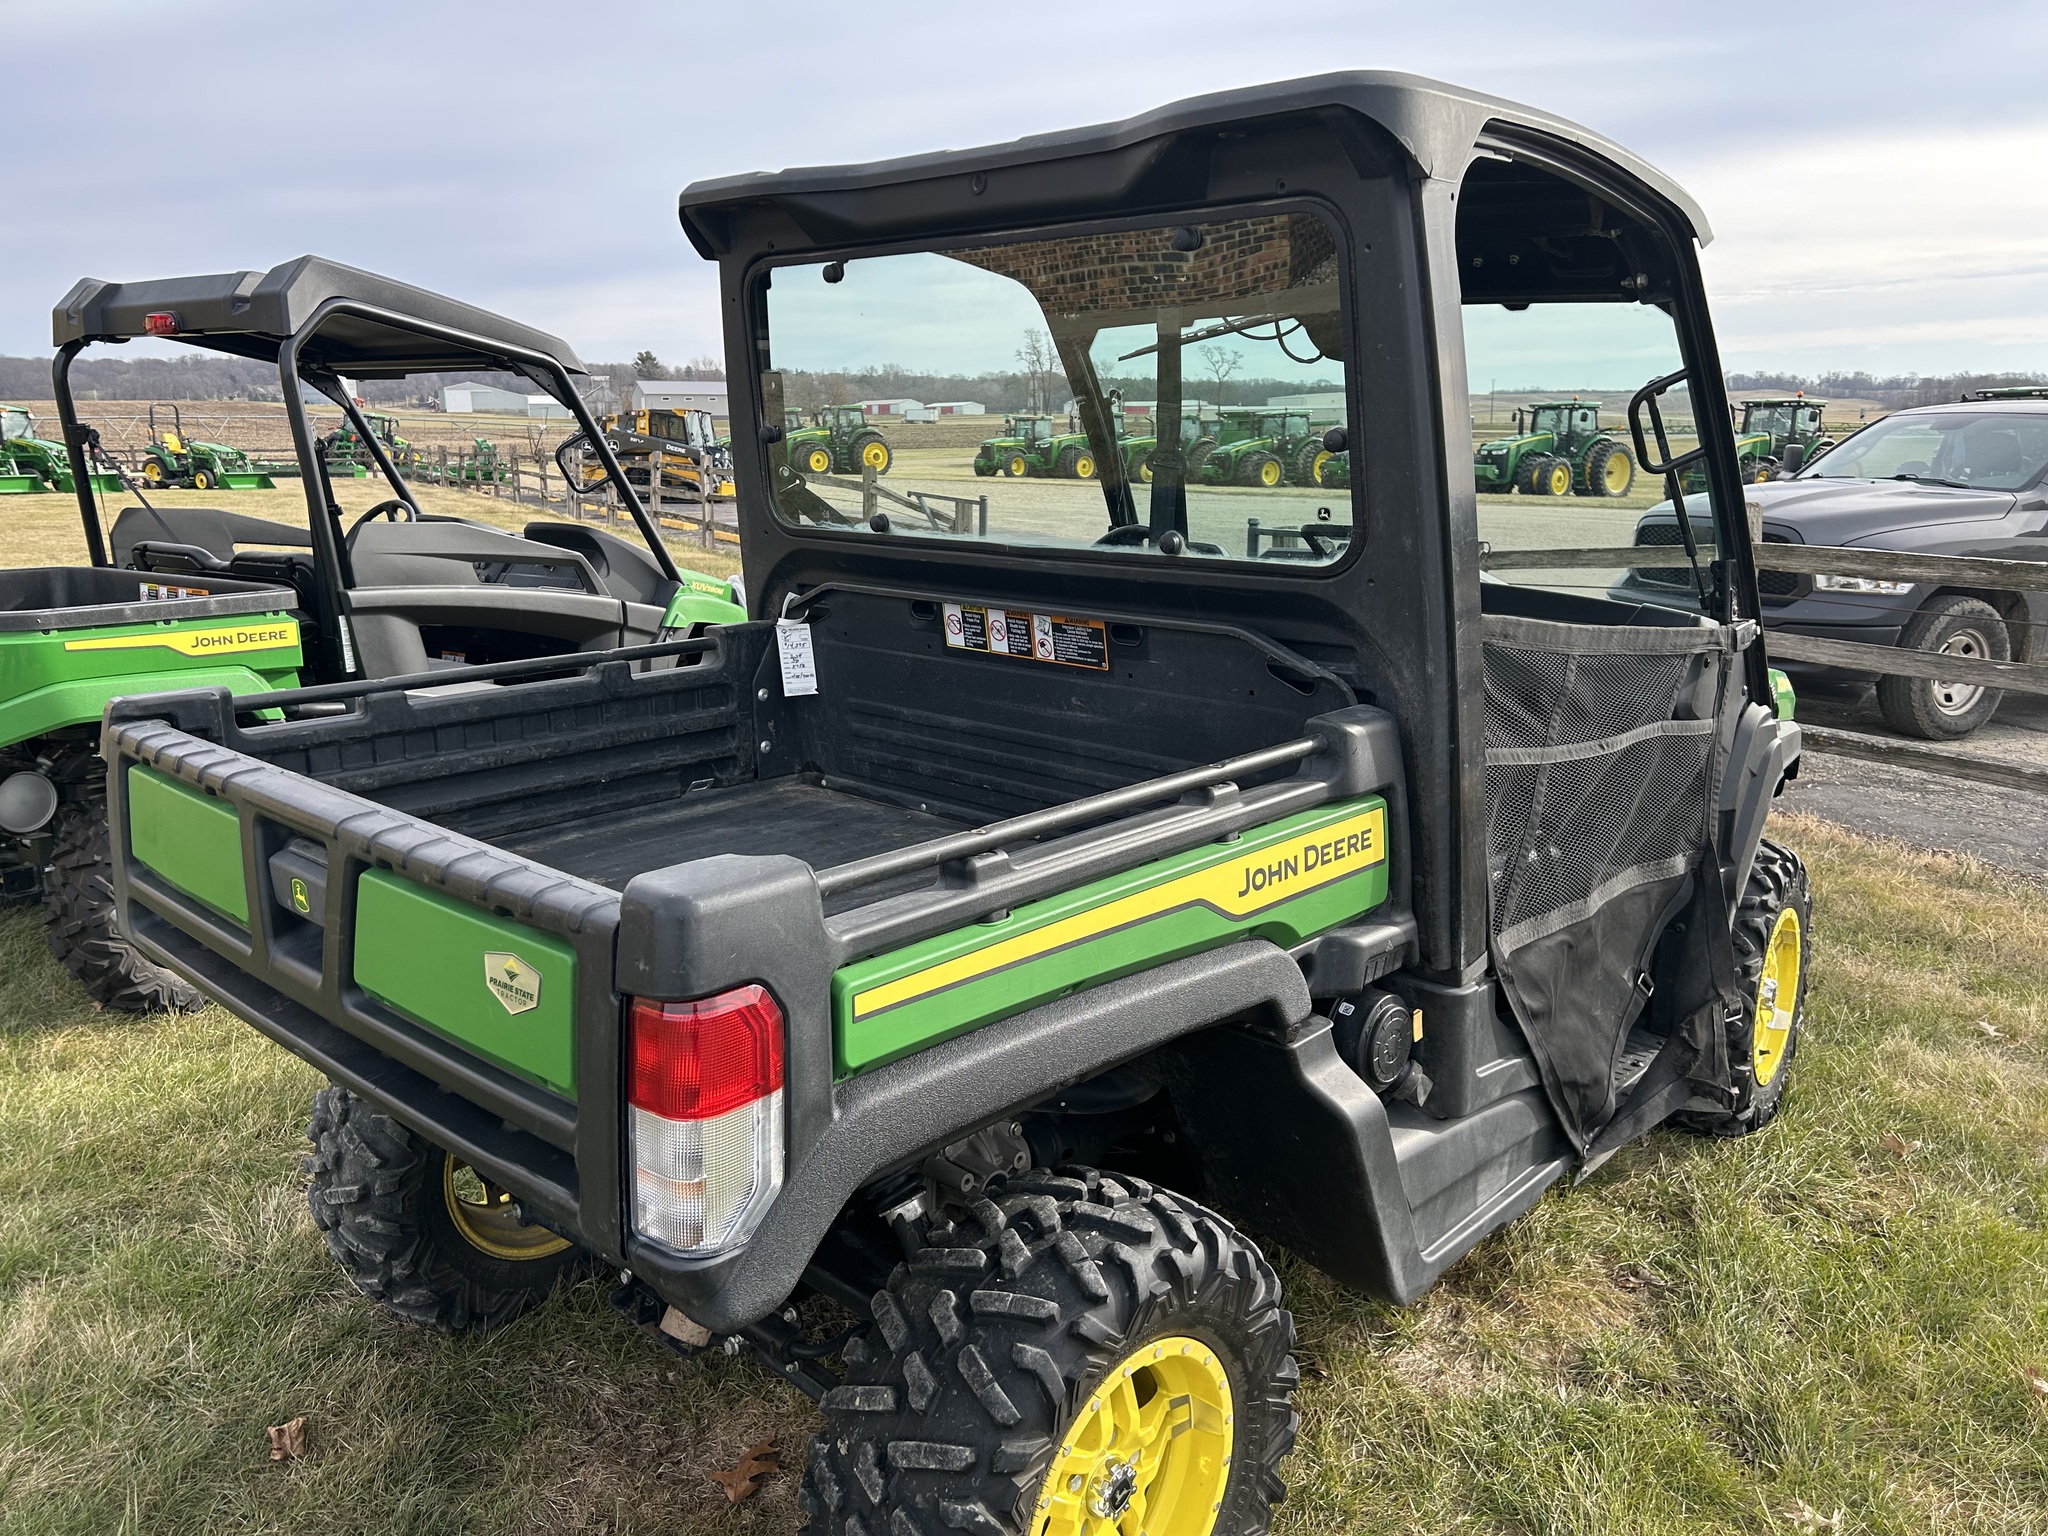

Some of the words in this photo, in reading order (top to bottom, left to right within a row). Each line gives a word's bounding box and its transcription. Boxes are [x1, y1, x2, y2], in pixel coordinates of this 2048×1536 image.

[666, 444, 687, 454] DEERE
[191, 635, 234, 649] JOHN
[237, 630, 288, 644] DEERE
[1238, 855, 1298, 898] JOHN
[1304, 828, 1372, 872] DEERE
[489, 976, 514, 994] PRAIRIE
[514, 987, 535, 1002] STATE
[496, 988, 527, 1007] TRACTOR
